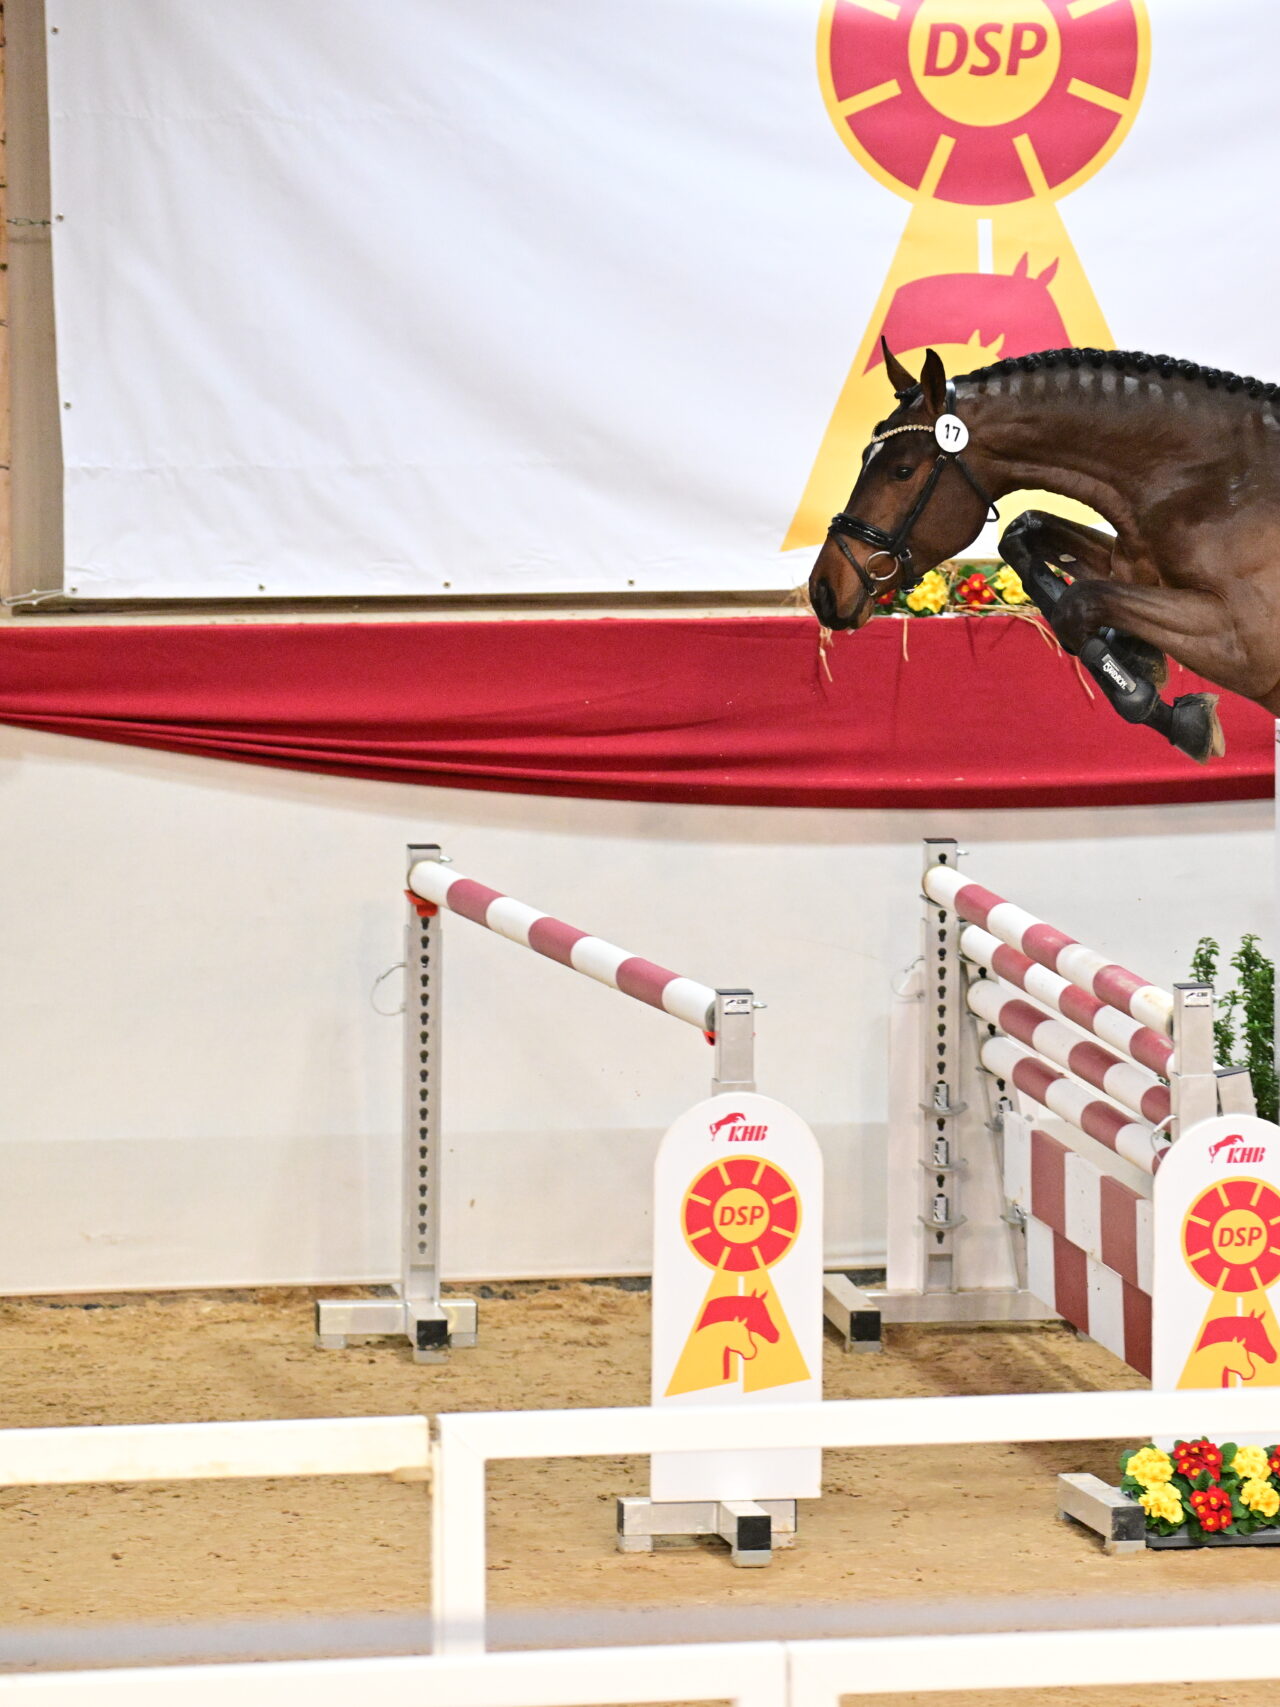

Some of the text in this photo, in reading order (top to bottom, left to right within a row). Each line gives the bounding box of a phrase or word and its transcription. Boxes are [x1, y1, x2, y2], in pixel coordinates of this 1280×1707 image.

[923, 22, 1048, 77] DSP
[945, 424, 961, 442] 17
[728, 1125, 768, 1142] KHB
[1226, 1147, 1266, 1164] KHB
[719, 1205, 765, 1226] DSP
[1218, 1226, 1263, 1247] DSP
